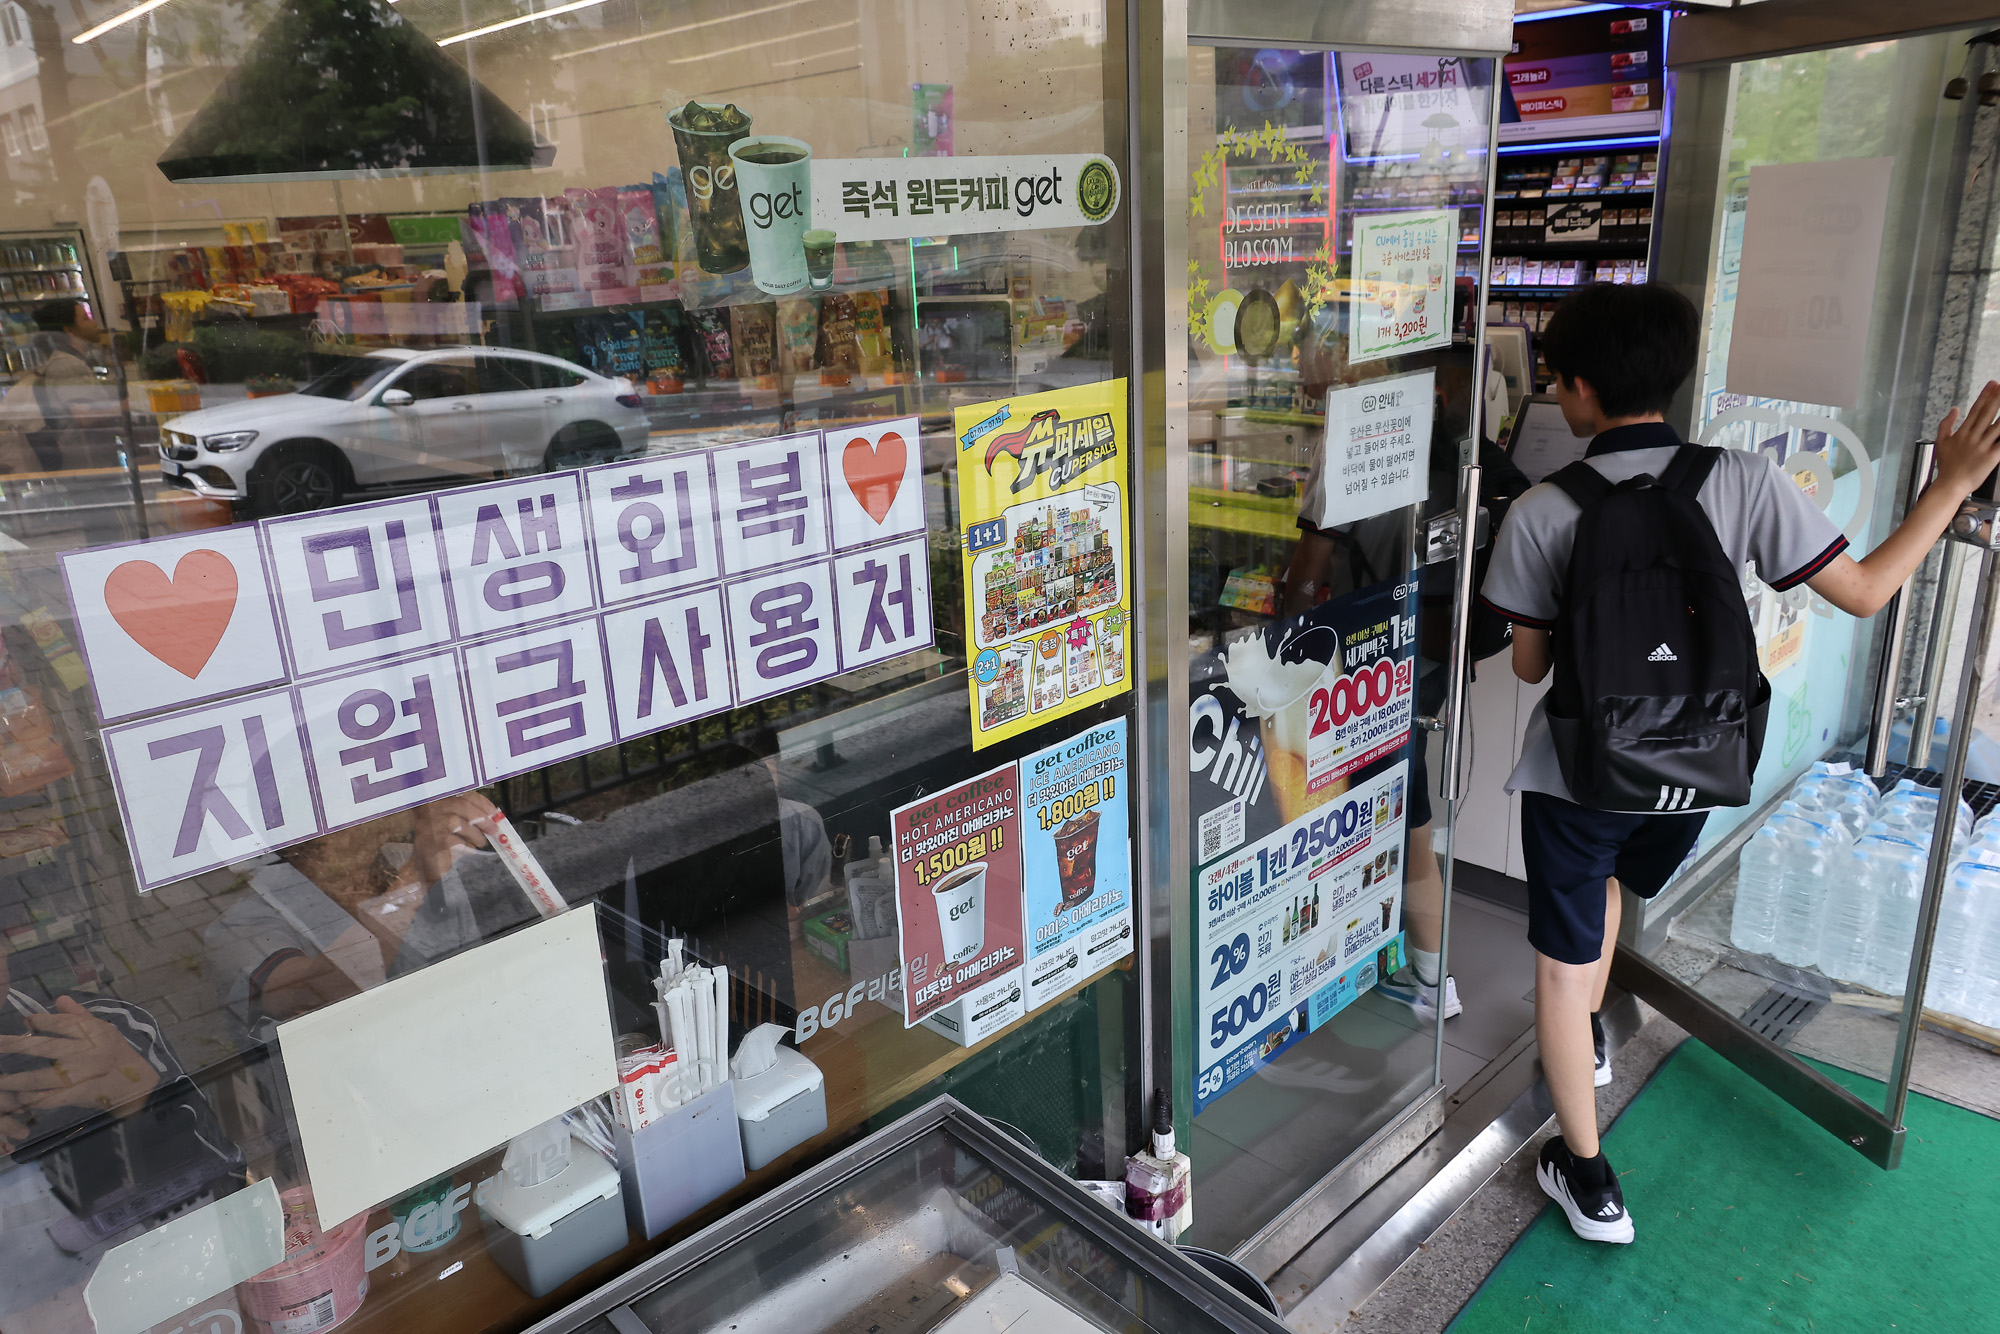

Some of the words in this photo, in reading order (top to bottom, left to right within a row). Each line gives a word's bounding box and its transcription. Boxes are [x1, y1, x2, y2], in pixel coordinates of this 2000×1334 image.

[1360, 76, 1385, 94] 다른
[1388, 73, 1412, 91] 스틱
[1416, 68, 1456, 88] 세가지
[689, 162, 734, 200] ge
[841, 176, 899, 218] 즉석
[906, 174, 1010, 217] 원두커피
[1014, 166, 1062, 217] get
[750, 183, 803, 229] get
[1226, 203, 1292, 234] DESSERT
[1225, 237, 1293, 269] BLOSSOM
[1376, 234, 1400, 247] CU에서
[1394, 248, 1421, 262] 아이스크림
[762, 281, 774, 289] YOUR
[787, 279, 802, 288] COFFEE
[1377, 325, 1391, 338] 1개
[1394, 316, 1428, 340] 3,200원
[1350, 424, 1372, 439] 우산은
[1375, 415, 1412, 435] 우산꽂이에
[1346, 444, 1361, 459] 넣고
[1364, 438, 1388, 454] 들어와
[1390, 433, 1414, 447] 주세요.
[1050, 452, 1092, 487] CUPER
[1094, 441, 1116, 461] SALE
[1343, 462, 1365, 477] 바닥에
[1369, 455, 1384, 471] 물이
[1386, 449, 1415, 466] 떨어지면
[1346, 478, 1368, 495] 넘어질
[1371, 476, 1378, 488] 수
[1381, 467, 1411, 486] 있습니다.
[973, 522, 1002, 548] 1+1
[301, 451, 808, 651] 민생회복
[1070, 626, 1088, 641] 특가
[1105, 614, 1122, 628] 3+1
[1357, 627, 1370, 640] 이상
[1041, 637, 1057, 652] 증정
[1344, 634, 1389, 668] 세계맥주
[1390, 614, 1416, 650] 1캔
[976, 657, 998, 676] 2+1
[1647, 653, 1678, 662] adidas
[1309, 656, 1413, 740] 2000원
[1335, 729, 1347, 741] 8캔
[1347, 722, 1359, 734] 이상
[1360, 718, 1371, 729] 구매
[1371, 712, 1378, 723] 시
[1350, 734, 1361, 749] 추가
[1362, 722, 1388, 744] 2,000원
[1035, 750, 1062, 775] get
[1066, 730, 1116, 759] coffee
[1190, 693, 1268, 807] Chill
[1030, 771, 1050, 791] ICE
[1053, 742, 1120, 781] AMERICANO
[1027, 791, 1038, 808] 더
[1039, 774, 1078, 803] 맛있어진
[1079, 756, 1125, 785] 아메리카노
[909, 801, 941, 827] get
[945, 776, 1005, 809] coffee
[1037, 781, 1101, 831] 1,800원
[901, 822, 930, 846] HOT
[934, 788, 1013, 832] AMERICANO
[901, 845, 913, 864] 더
[915, 825, 960, 858] 맛있어진
[961, 805, 1015, 837] 아메리카노
[914, 832, 988, 886] 1,500원
[1066, 839, 1088, 861] get
[1207, 867, 1255, 912] 하이볼
[1256, 843, 1287, 888] 1캔
[1291, 796, 1373, 869] 2500원
[1327, 849, 1336, 859] 추가
[1068, 883, 1088, 900] coffee
[1226, 903, 1236, 917] 이상
[1252, 883, 1277, 904] 12,000원
[1332, 883, 1345, 900] 인기
[1345, 886, 1358, 903] 안주
[949, 895, 976, 921] get
[1036, 914, 1070, 942] 아이스
[1071, 888, 1123, 924] 아메리카노
[952, 941, 979, 961] coffee
[1257, 942, 1272, 959] 주류
[1258, 929, 1272, 947] 인기
[955, 945, 1016, 985] 아메리카노
[1210, 932, 1250, 991] 20%
[1289, 958, 1315, 984] 08-14시
[1210, 969, 1281, 1049] 500원
[1268, 994, 1281, 1012] 할인
[1197, 1065, 1224, 1100] 50%
